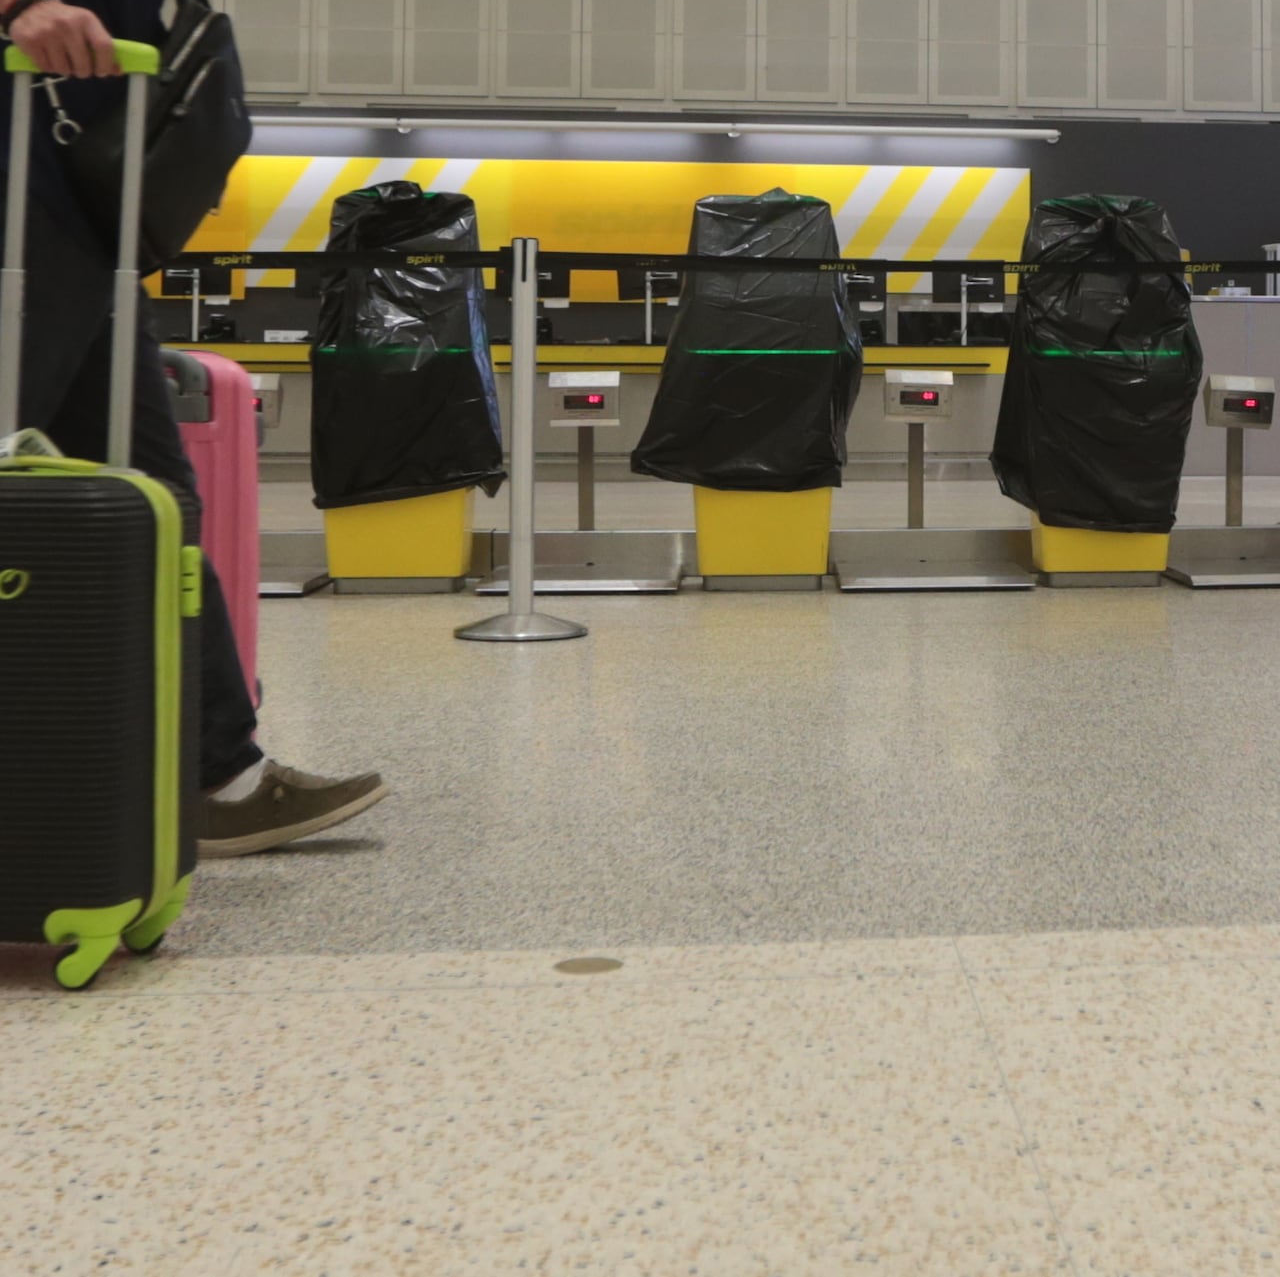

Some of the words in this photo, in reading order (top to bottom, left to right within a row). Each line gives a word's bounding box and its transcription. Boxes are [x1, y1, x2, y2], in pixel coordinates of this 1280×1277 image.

[213, 254, 253, 265] spirit
[406, 254, 445, 265] spirit
[1184, 263, 1221, 273] spirit
